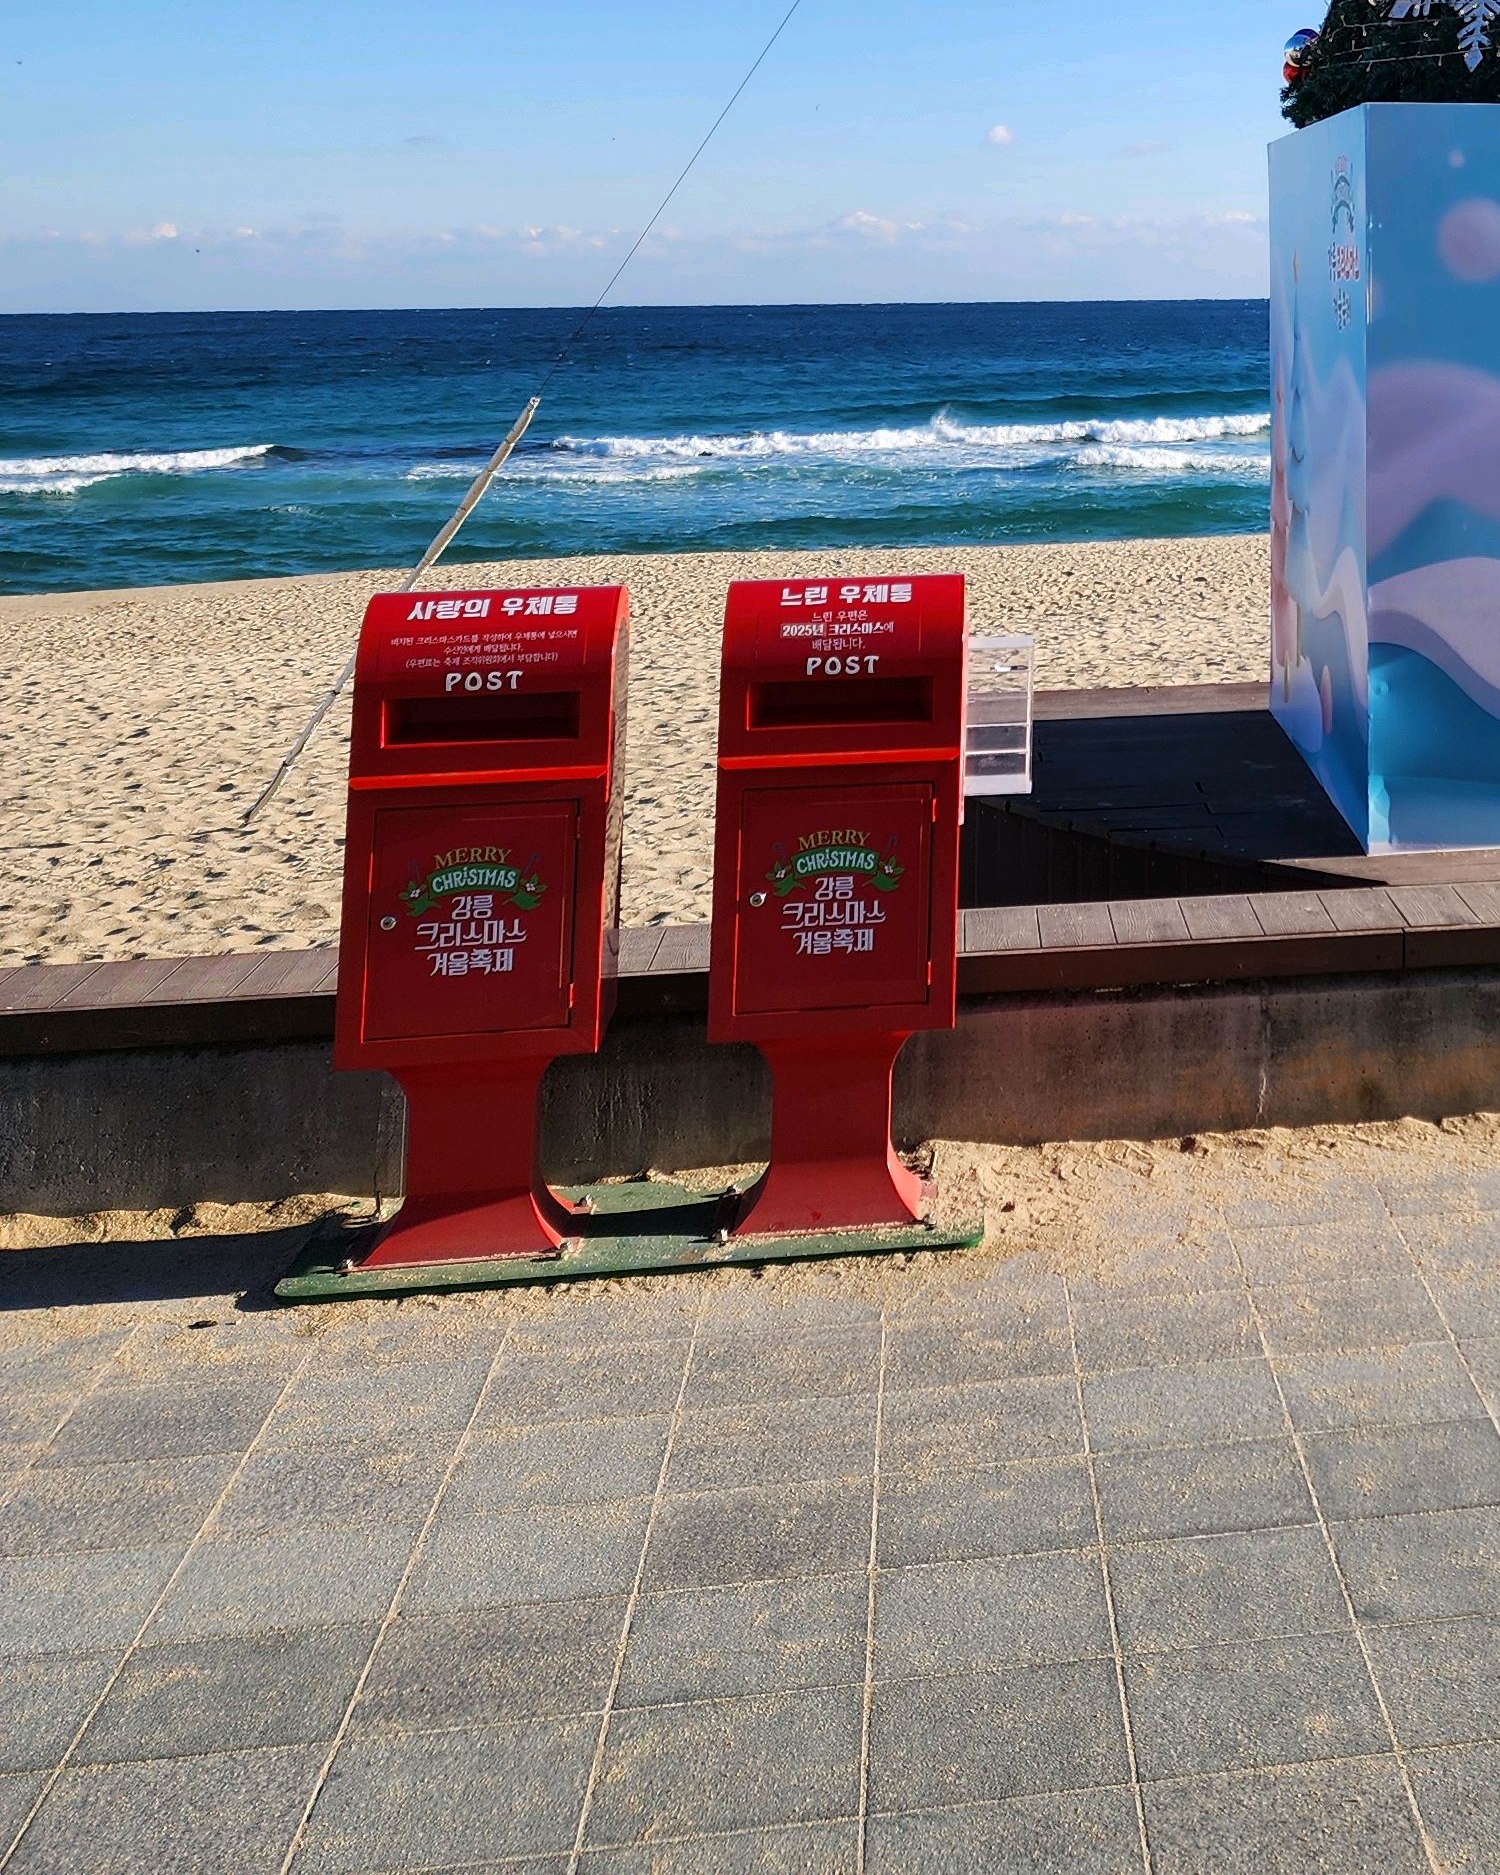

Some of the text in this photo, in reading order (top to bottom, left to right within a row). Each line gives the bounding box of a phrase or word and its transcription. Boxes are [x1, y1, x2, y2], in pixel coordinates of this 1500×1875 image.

[780, 583, 912, 606] 느린 우체통
[406, 595, 578, 621] 사랑의 우체통
[811, 609, 868, 622] 느린 우편은
[415, 633, 479, 646] 크리스마스카드를
[481, 631, 512, 643] 작성하여
[514, 630, 546, 641] 우체통에
[782, 621, 894, 637] 2025년 크리스마스에
[483, 643, 523, 654] 배달됩니다.
[811, 637, 866, 651] 배달됩니다.
[463, 654, 515, 666] 조직위원회에서
[806, 655, 880, 676] POST
[445, 670, 523, 692] POST
[798, 829, 871, 851] MERRY
[434, 846, 512, 870] MERRY
[815, 876, 854, 900] 강릉
[451, 894, 493, 920] 강릉
[781, 900, 886, 929] 크리스마스
[414, 918, 528, 950] 크리스마스
[793, 928, 874, 955] 겨울축제
[427, 948, 514, 977] 겨울축제
